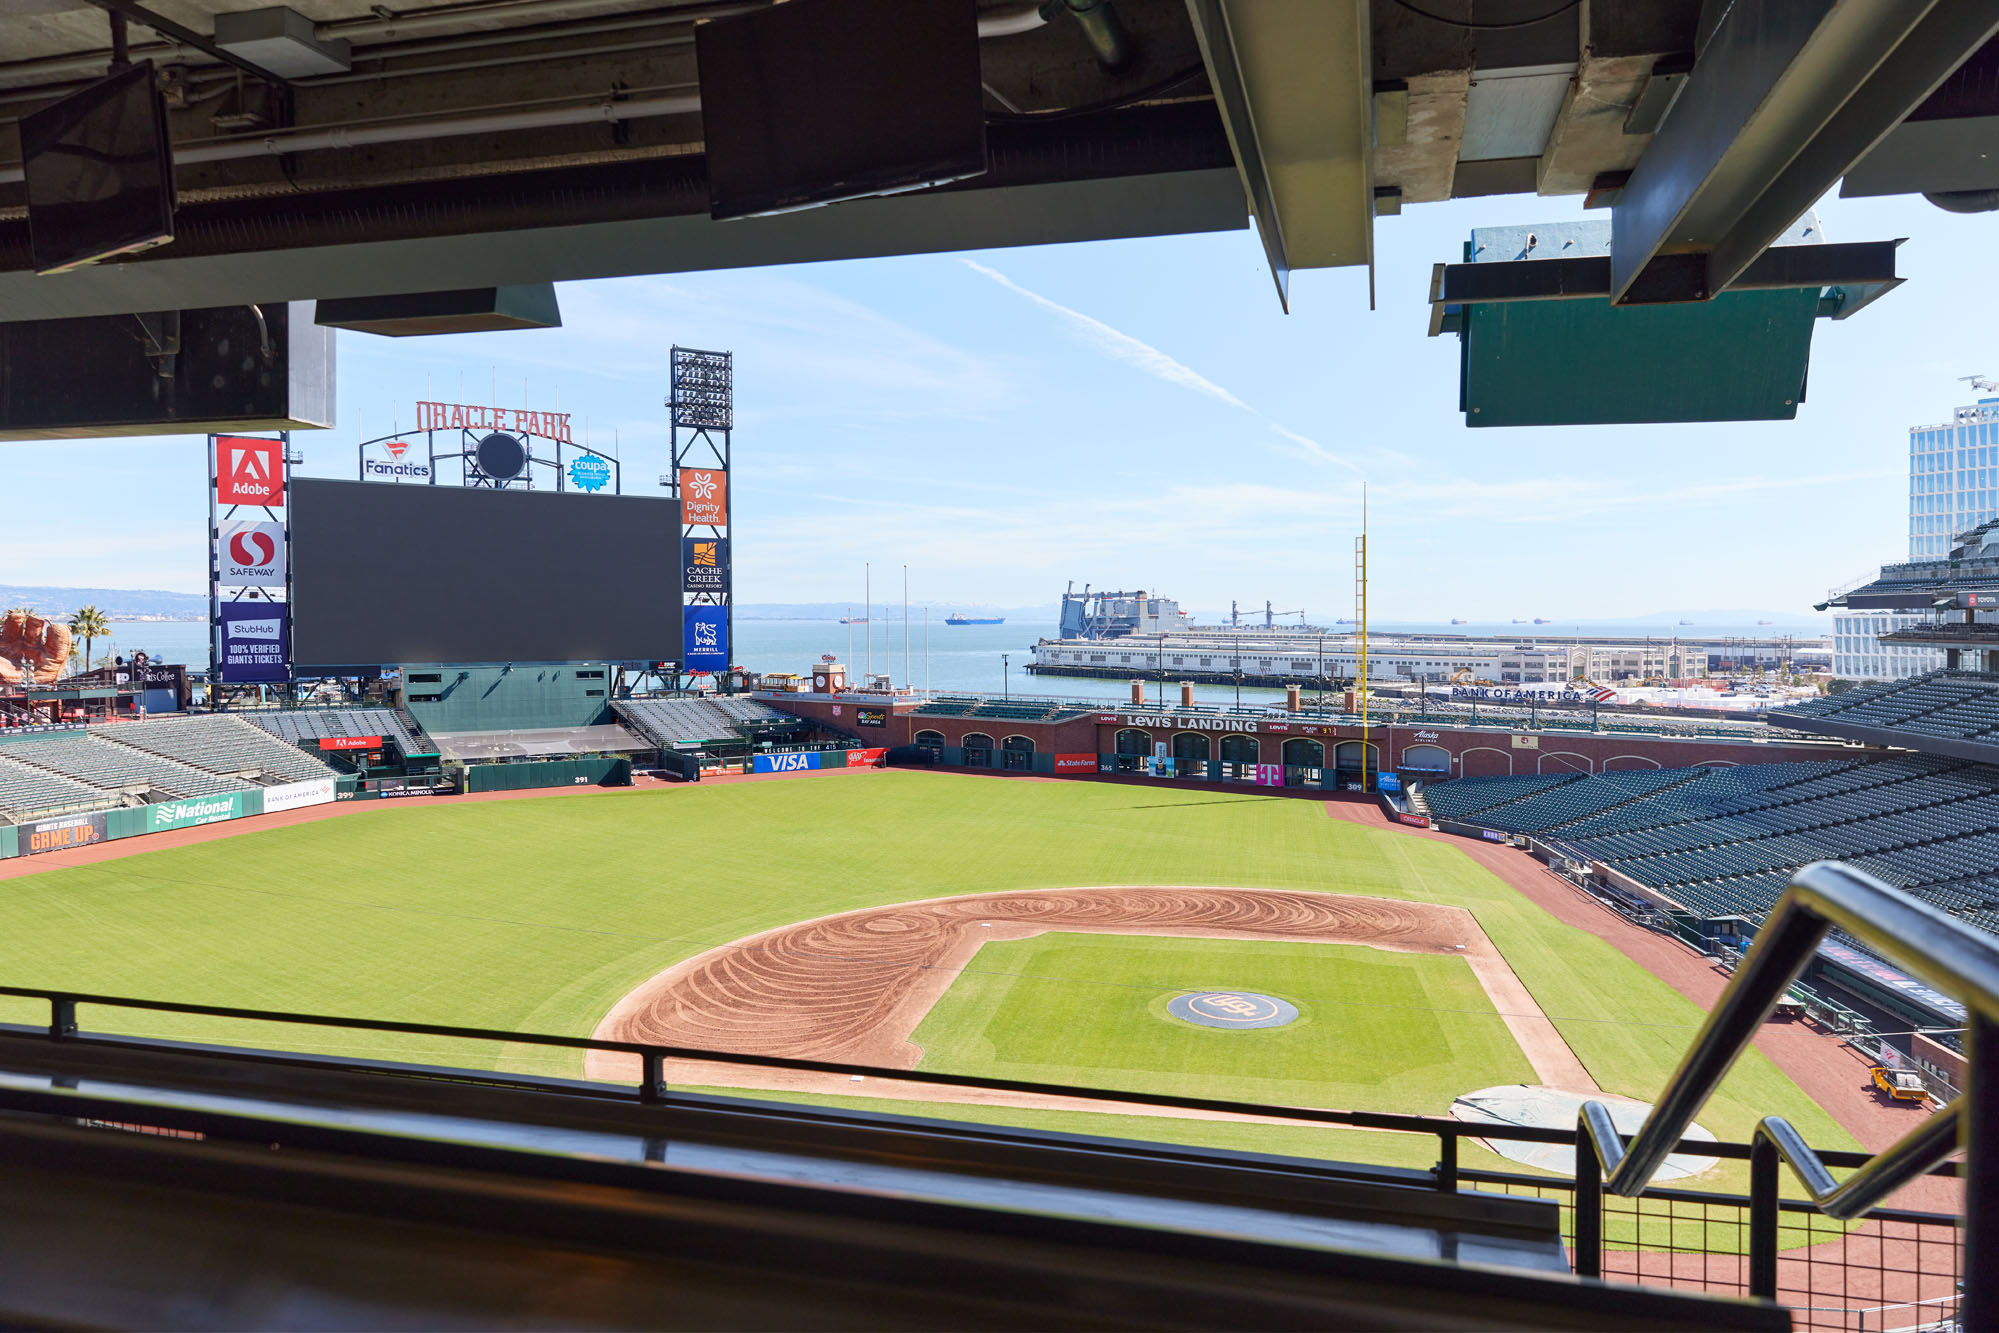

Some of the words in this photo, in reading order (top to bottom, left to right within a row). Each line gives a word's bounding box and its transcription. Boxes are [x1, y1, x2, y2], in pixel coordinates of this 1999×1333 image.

[416, 401, 506, 432] ORACLE
[514, 409, 572, 443] PARK
[366, 460, 429, 476] Fanatics
[575, 461, 607, 473] coupa
[232, 482, 270, 495] Adobe
[687, 501, 720, 513] Dignity
[230, 567, 275, 576] SAFEWAY
[687, 566, 722, 574] CACHE
[688, 574, 721, 583] CREEK
[234, 625, 274, 633] StubHub
[229, 644, 248, 654] 100%
[249, 644, 280, 654] VERIFIED
[227, 655, 253, 664] GIANTS
[254, 654, 283, 664] TICKETS
[156, 671, 175, 682] Coffee
[1452, 687, 1489, 699] BANK
[1493, 688, 1511, 699] OF
[1515, 689, 1581, 701] AMERICA
[866, 711, 885, 720] Sports
[1177, 718, 1258, 733] LANDING
[1413, 730, 1439, 739] Alaska
[767, 754, 809, 771] VISA
[1347, 783, 1362, 791] 309
[267, 795, 284, 803] BANK
[293, 790, 319, 799] AMERICA
[175, 797, 234, 820] National
[208, 812, 231, 823] Rental
[35, 822, 58, 832] GIANTS
[59, 818, 88, 829] BASEBALL
[30, 828, 72, 850] GAME
